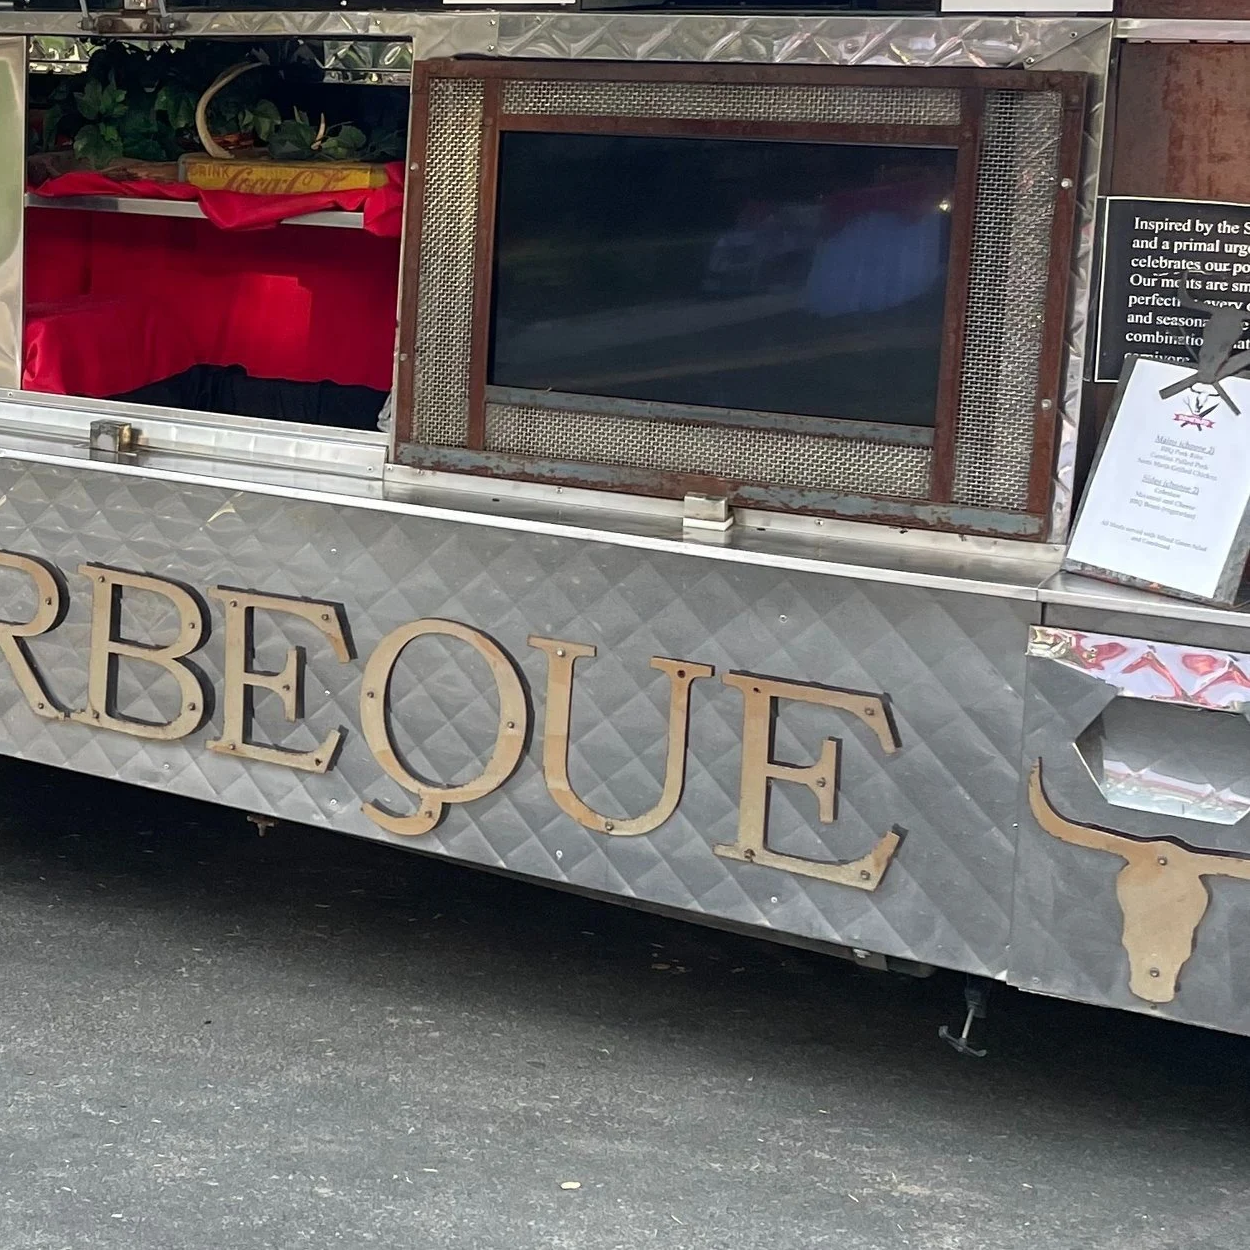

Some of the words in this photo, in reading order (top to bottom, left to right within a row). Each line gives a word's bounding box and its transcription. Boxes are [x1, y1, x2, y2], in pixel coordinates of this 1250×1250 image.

[1134, 217, 1191, 233] Inspired
[1196, 220, 1213, 236] by
[1218, 221, 1240, 234] the
[1132, 237, 1158, 249] and
[1162, 240, 1169, 250] a
[1174, 238, 1220, 253] primal
[1131, 255, 1201, 270] celebrates
[1205, 262, 1230, 271] our
[1130, 273, 1158, 287] Our
[1206, 281, 1228, 291] are
[1127, 312, 1153, 324] and
